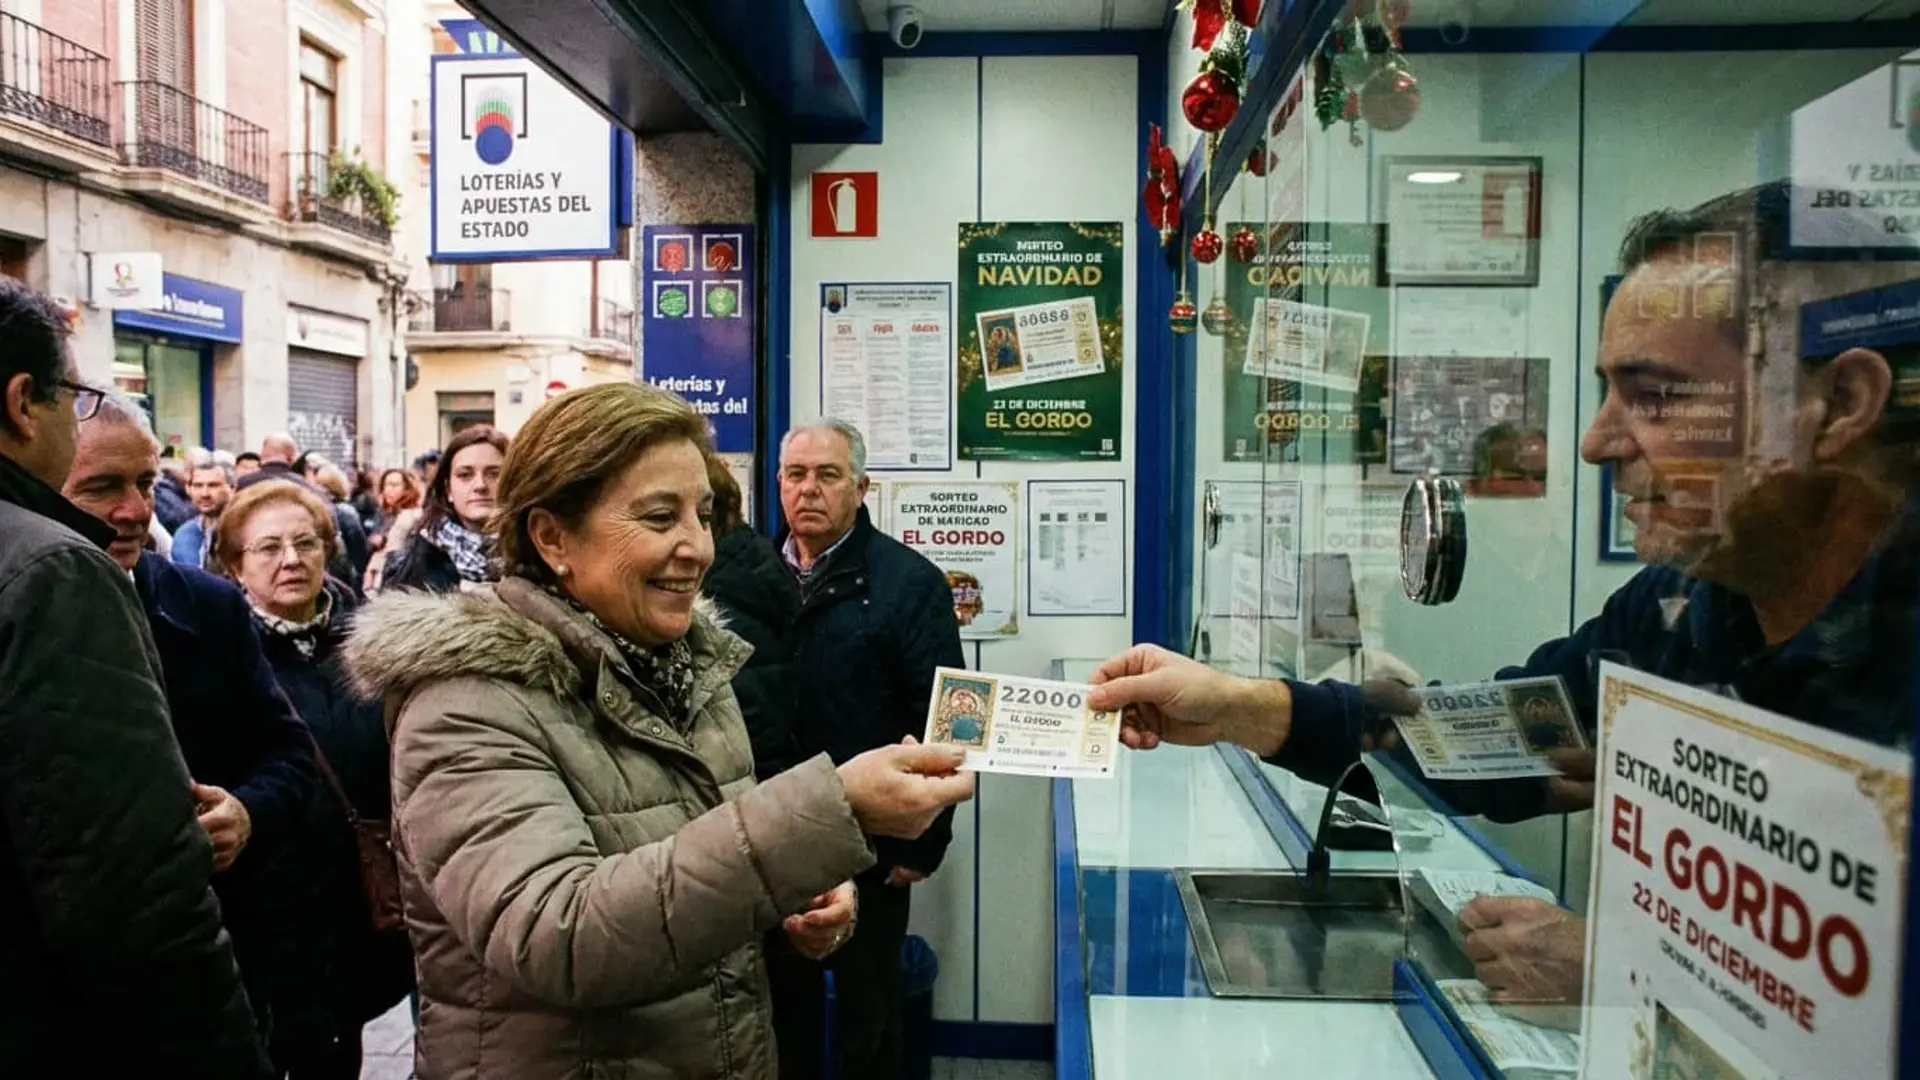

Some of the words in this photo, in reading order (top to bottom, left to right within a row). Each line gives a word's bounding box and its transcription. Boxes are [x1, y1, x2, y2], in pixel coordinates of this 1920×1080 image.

[461, 170, 545, 191] LOTERÍAS
[551, 171, 562, 190] Y
[461, 197, 551, 215] APUESTAS
[558, 195, 591, 213] DEL
[461, 221, 529, 239] ESTADO
[978, 265, 1103, 286] NAVIDAD
[715, 379, 726, 396] y
[985, 412, 1011, 428] EL
[1015, 412, 1093, 428] GORDO
[929, 492, 979, 502] SORTEO
[901, 504, 1008, 514] EXTRAORDINARIO
[918, 516, 933, 526] DE
[903, 530, 926, 545] EL
[932, 530, 1005, 545] GORDO
[1001, 686, 1082, 708] 22000
[1672, 738, 1769, 802] SORTEO
[1615, 750, 1820, 873] EXTRAORDINARIO
[1830, 848, 1878, 905] DE
[1612, 794, 1652, 869] EL
[1664, 827, 1870, 997] GORDO
[1632, 881, 1652, 914] 22
[1656, 901, 1681, 935] DE
[1686, 916, 1816, 1033] DICIEMBRE
